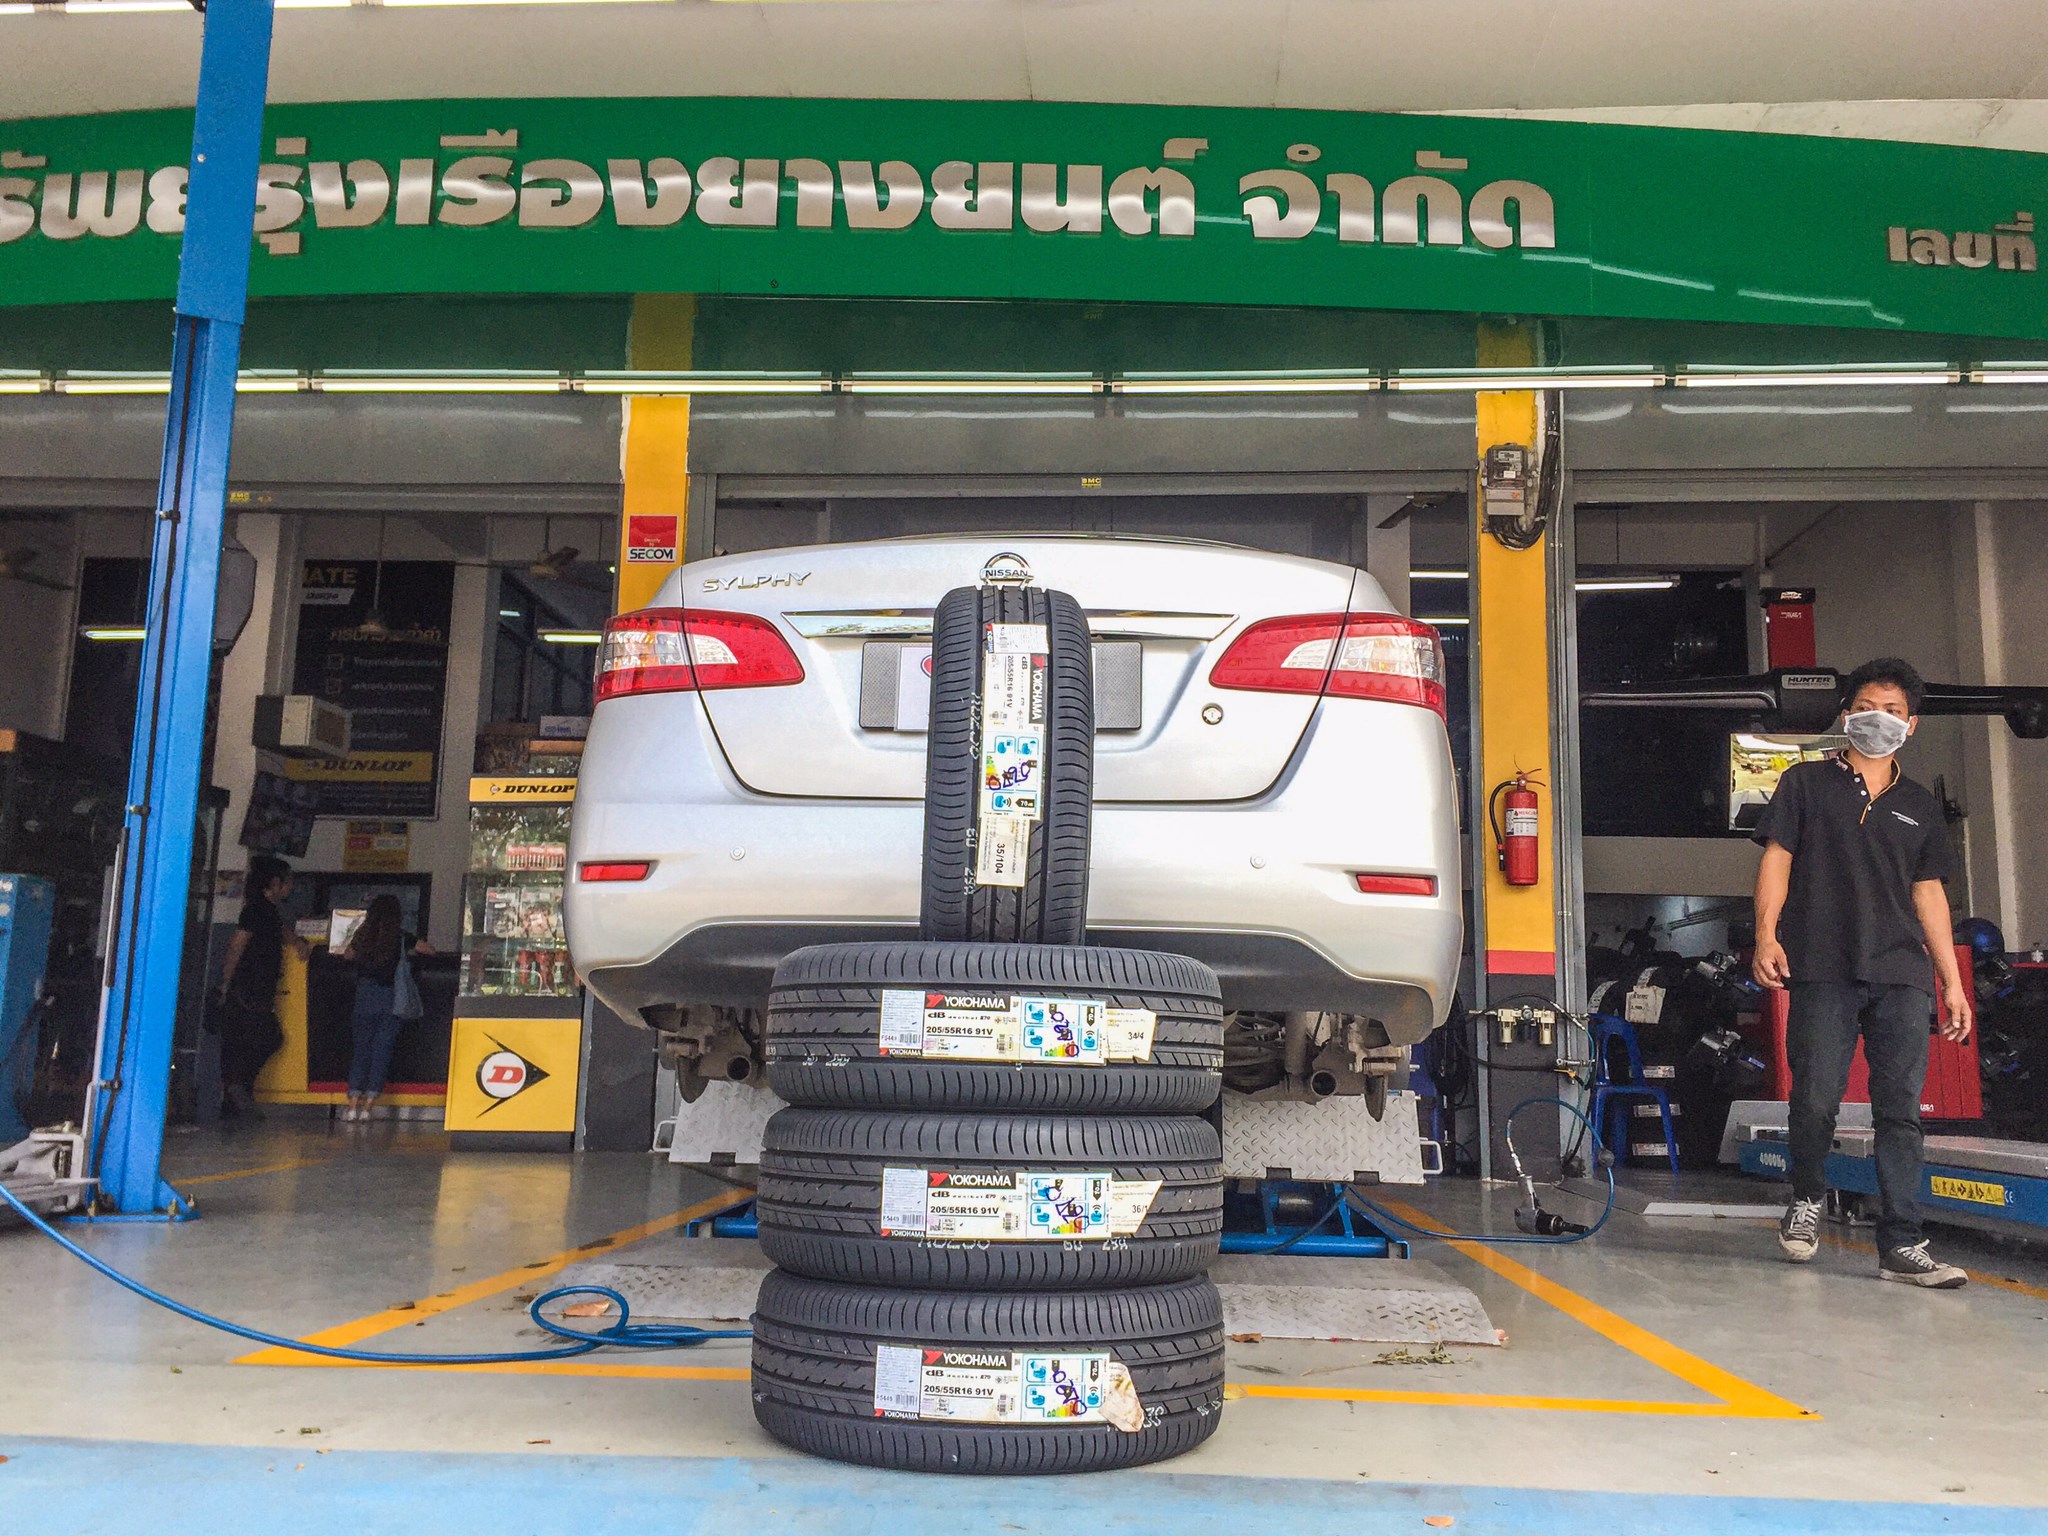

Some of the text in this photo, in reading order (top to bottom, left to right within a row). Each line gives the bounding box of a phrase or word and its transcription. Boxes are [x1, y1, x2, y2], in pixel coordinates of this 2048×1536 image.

[1238, 143, 1556, 250] จำกัด
[1886, 211, 2038, 272] เลขที่
[630, 549, 673, 560] SECOM
[985, 569, 1028, 577] NISSAN
[702, 572, 812, 593] SYLPHY
[1787, 676, 1831, 684] HUNTER
[1031, 668, 1043, 721] YOKOHAMA
[323, 759, 413, 772] DUNLOP
[503, 785, 575, 794] DUNLOP
[995, 843, 1005, 874] 35/104
[944, 996, 1006, 1009] YOKOHAMA
[926, 1026, 993, 1036] 205/55R16 91V
[888, 1048, 921, 1056] YOKOHAMA
[486, 1065, 524, 1084] D
[948, 1174, 1012, 1187] YOKOHAMA
[930, 1206, 999, 1215] 205/55R16 91V
[890, 1230, 925, 1238] YOKOHAMA
[943, 1352, 1007, 1367] YOKOHAMA
[924, 1385, 994, 1396] 205/55R16 91V
[884, 1410, 919, 1420] YOKOHAMA
